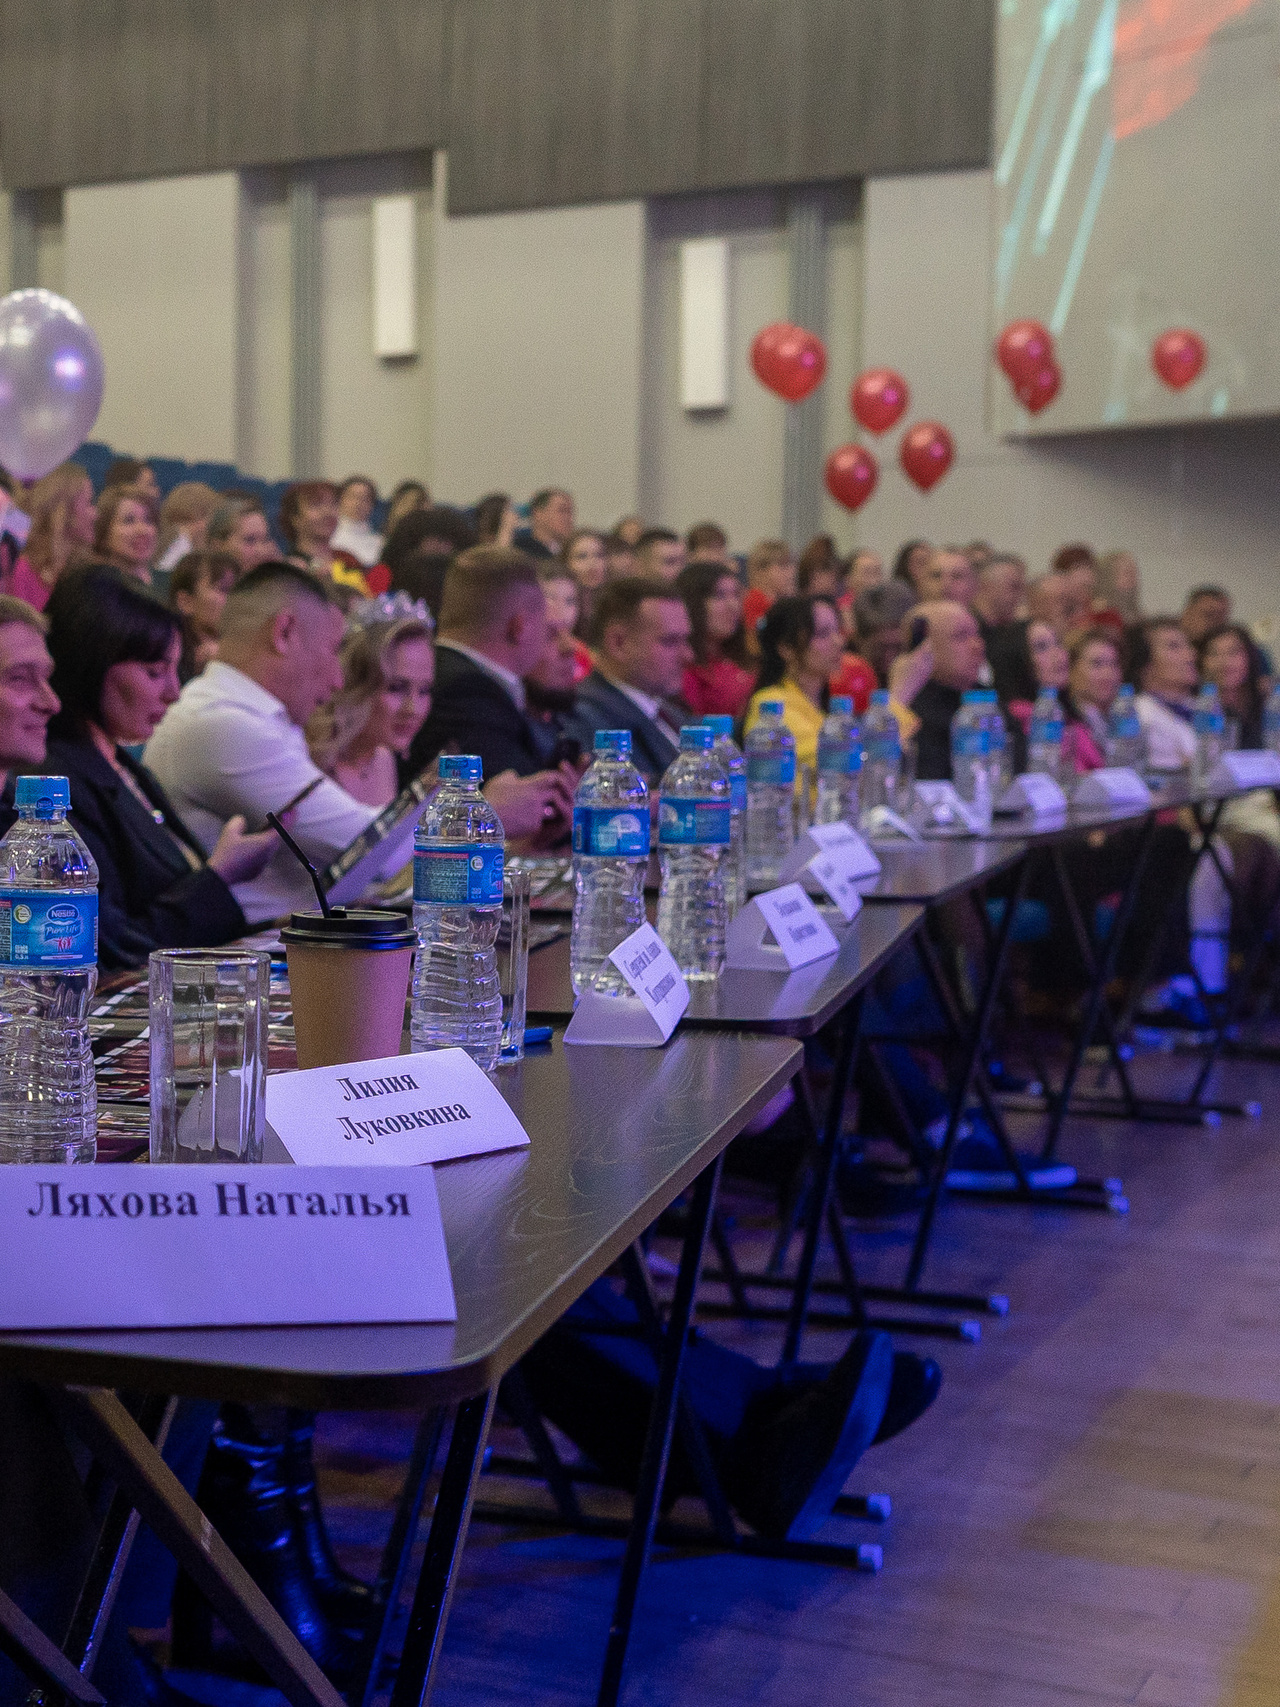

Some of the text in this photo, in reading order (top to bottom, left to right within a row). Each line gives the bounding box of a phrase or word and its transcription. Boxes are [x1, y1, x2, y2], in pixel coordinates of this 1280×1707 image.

[336, 1074, 420, 1101] Лилия
[336, 1103, 472, 1145] Луковкина
[28, 1182, 411, 1218] Ляхова Наталья
